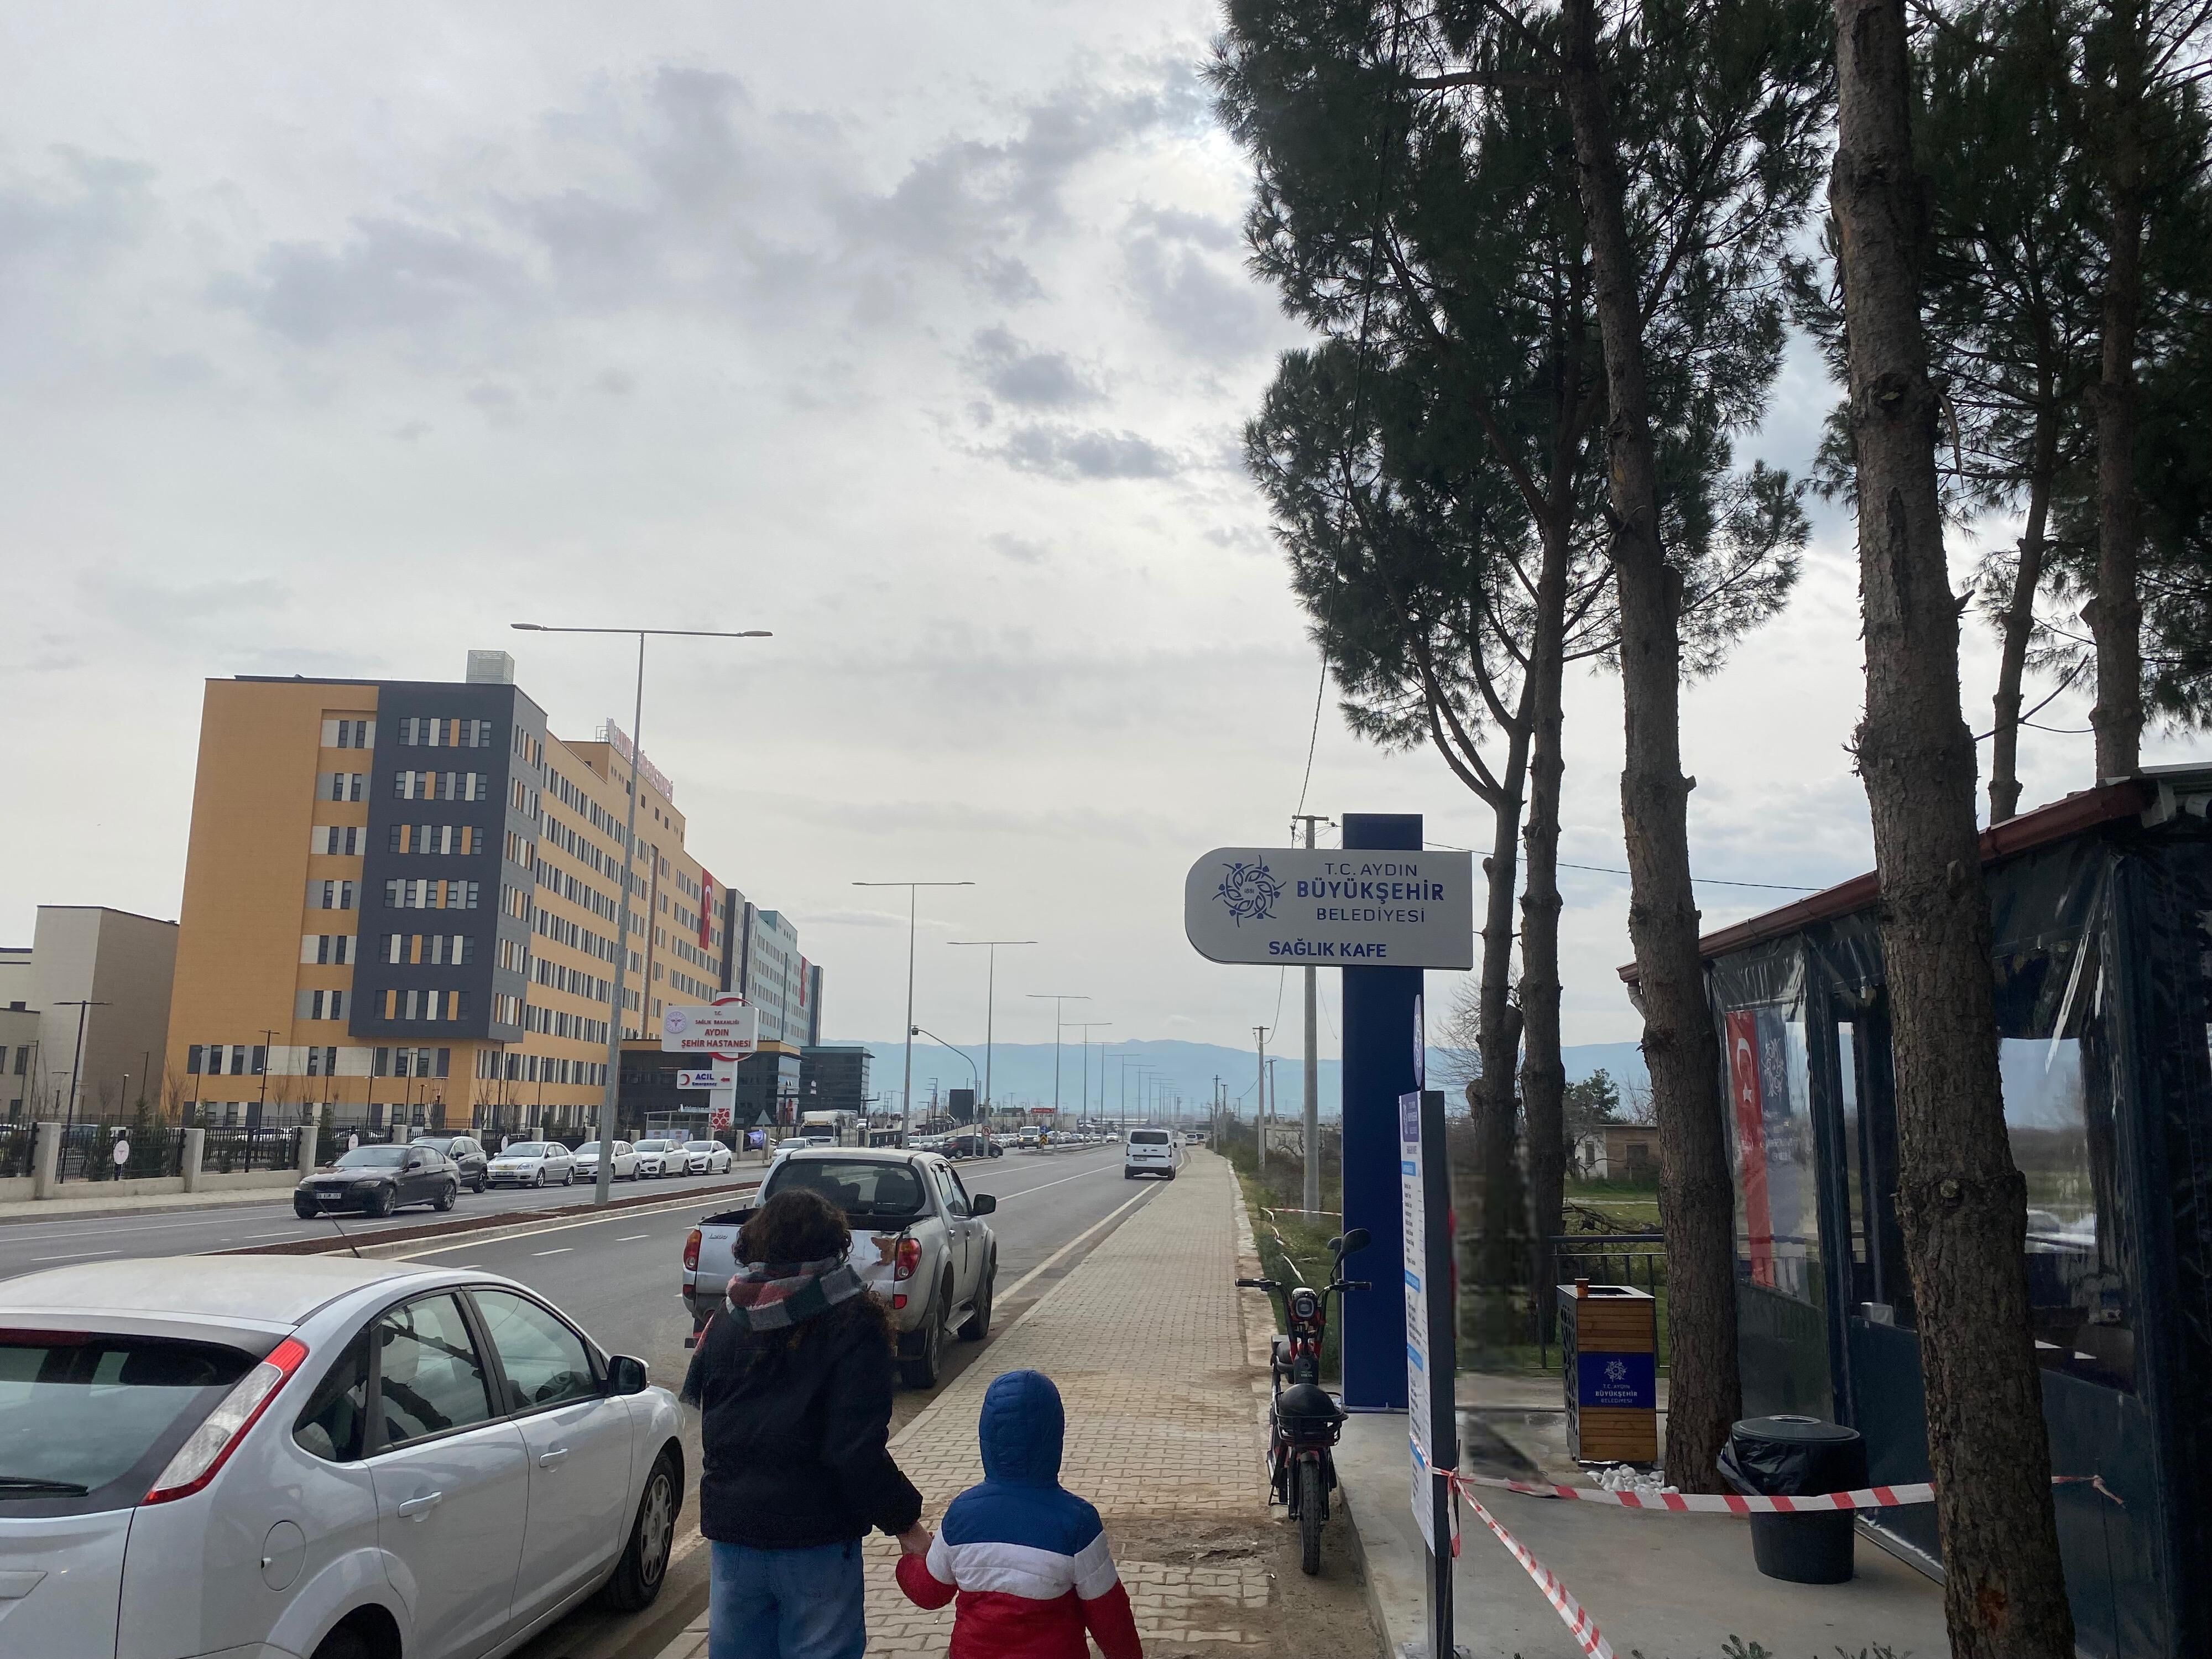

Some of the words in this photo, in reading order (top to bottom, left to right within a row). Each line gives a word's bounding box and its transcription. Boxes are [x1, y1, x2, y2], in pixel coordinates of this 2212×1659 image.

[1324, 863, 1356, 875] T.C.
[1360, 863, 1417, 877] AYDIN
[1297, 877, 1444, 905] BÜYÜKŞEHİR
[1317, 906, 1425, 922] BELEDİYESİ
[1269, 938, 1334, 956] SAĞLIK
[1340, 942, 1387, 957] KAFE
[681, 1038, 705, 1048] ŞEHİR
[707, 1039, 751, 1047] HASTANESİ
